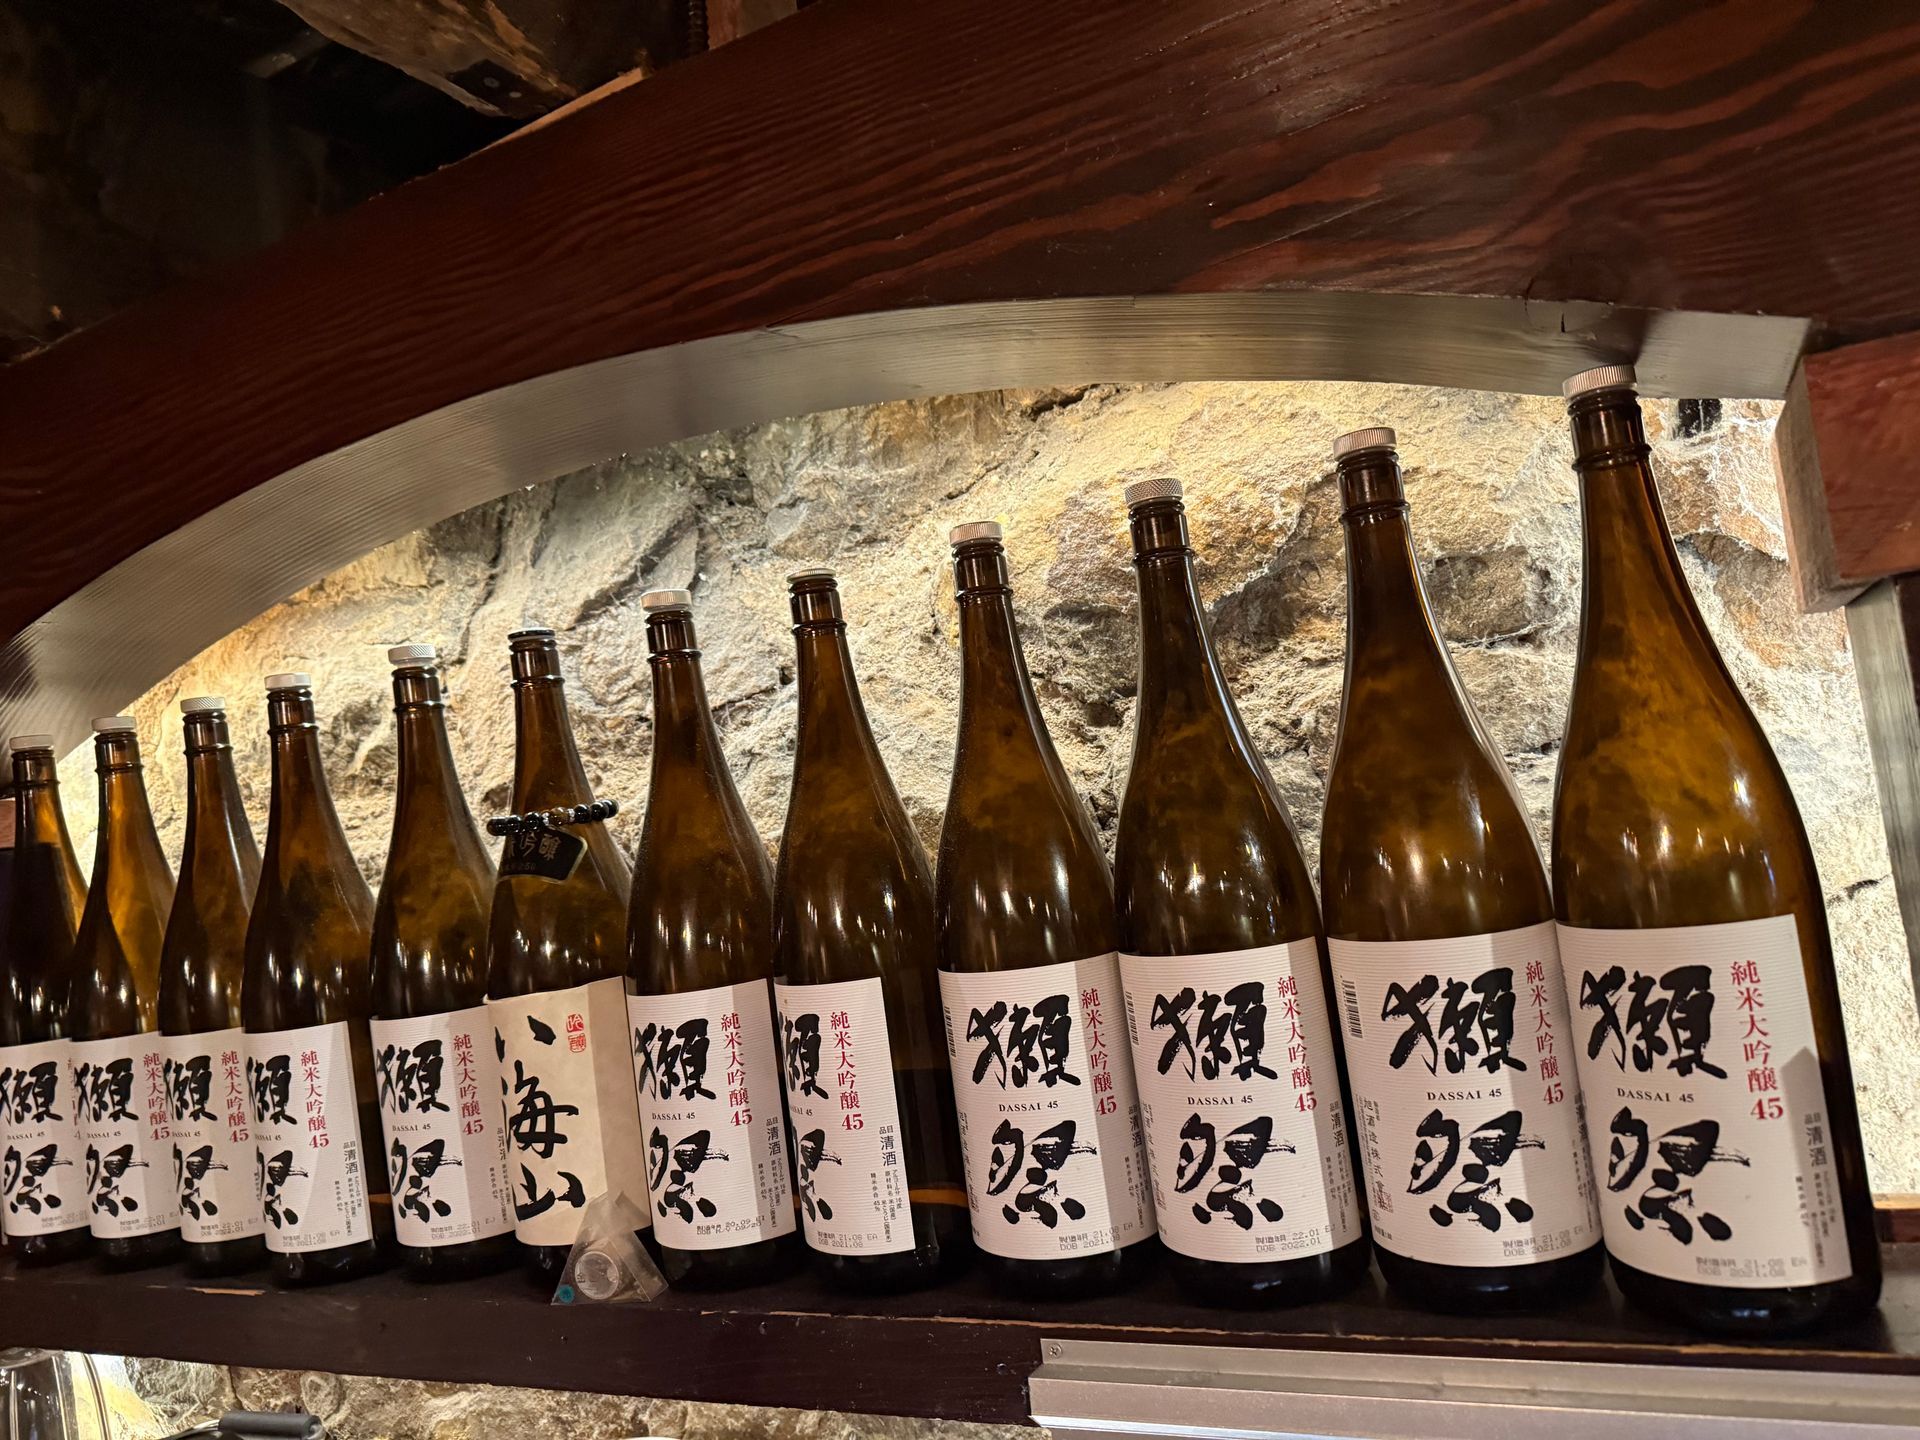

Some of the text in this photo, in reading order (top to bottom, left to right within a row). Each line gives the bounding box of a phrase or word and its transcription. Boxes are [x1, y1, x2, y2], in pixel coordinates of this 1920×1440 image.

[1187, 1094, 1254, 1106] DASSAI 45
[1426, 1088, 1502, 1101] DASSAI 45
[1616, 1087, 1695, 1103] DASSAI 45
[998, 1100, 1059, 1112] DASSAI 45
[495, 1015, 586, 1222] 八海山
[651, 1112, 696, 1121] DASSAI 45
[391, 1123, 431, 1132] DASSAI 45
[880, 1136, 897, 1167] 清酒
[1292, 1228, 1320, 1240] 22.01
[1281, 1237, 1321, 1250] 2022.01
